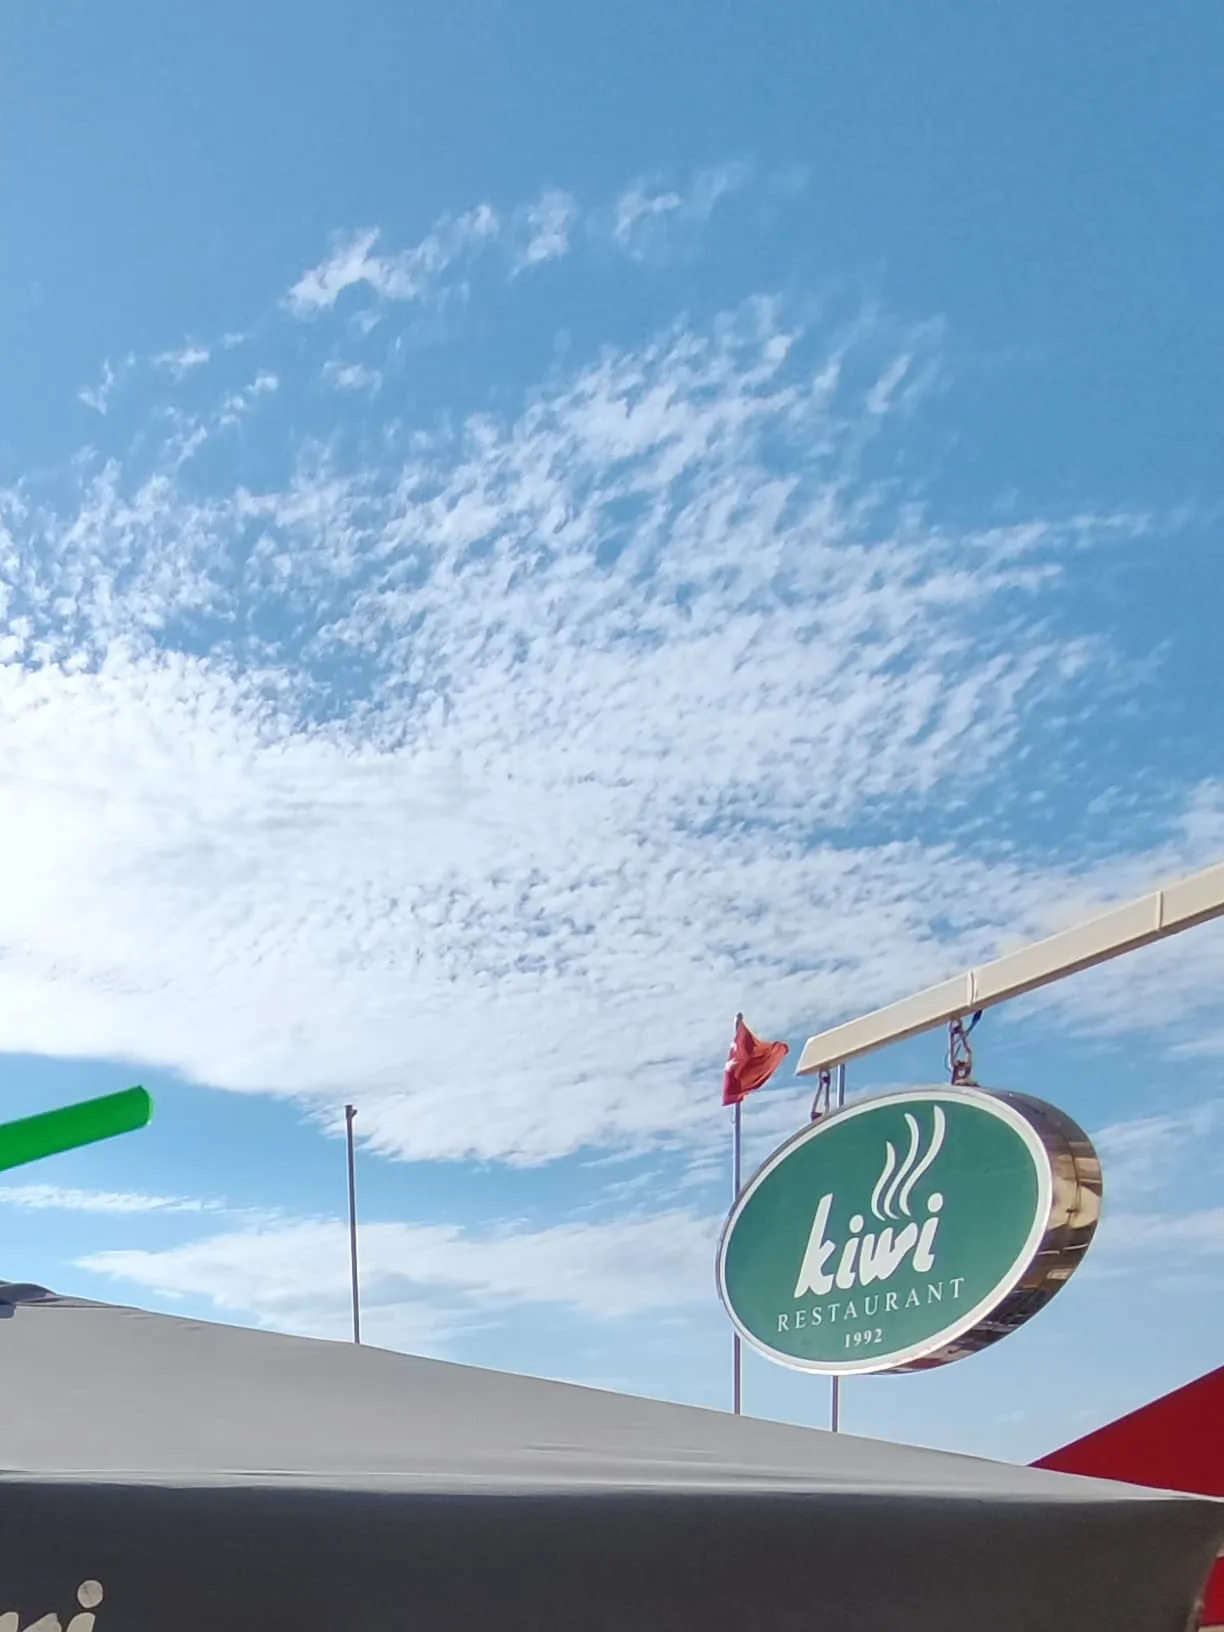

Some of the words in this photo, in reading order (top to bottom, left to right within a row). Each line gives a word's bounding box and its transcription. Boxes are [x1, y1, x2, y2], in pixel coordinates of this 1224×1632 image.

[793, 1192, 944, 1299] kiwi
[777, 1276, 966, 1333] RESTAURANT
[843, 1327, 883, 1349] 1992
